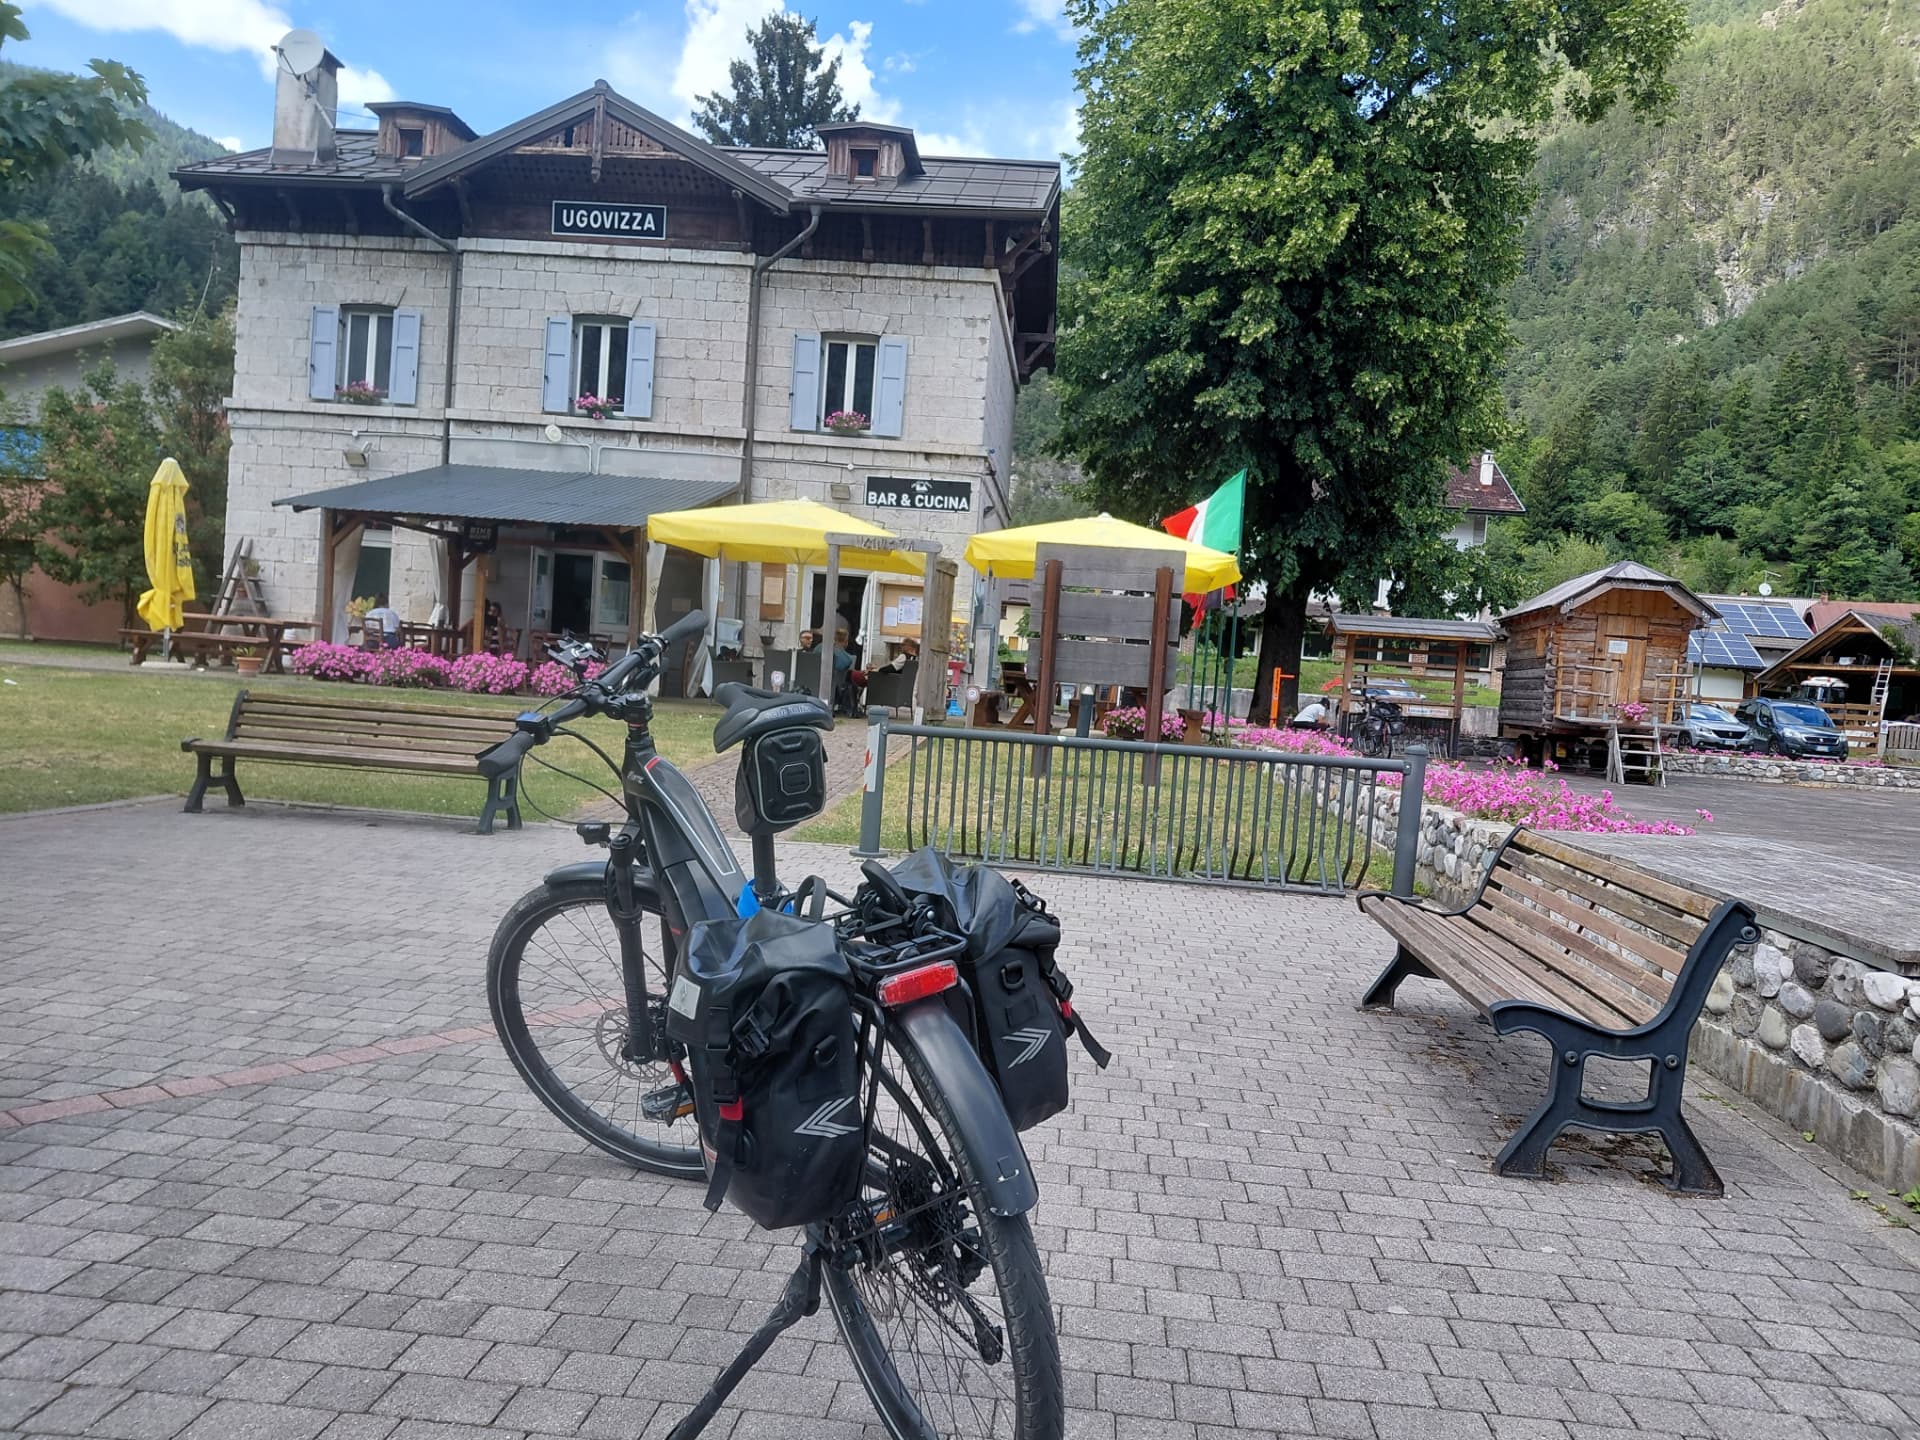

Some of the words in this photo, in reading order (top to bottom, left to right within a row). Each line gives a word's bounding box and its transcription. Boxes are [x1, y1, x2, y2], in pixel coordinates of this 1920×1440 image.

[562, 209, 656, 231] UGOVIZZA
[867, 491, 897, 506] BAR
[900, 493, 911, 507] &
[914, 494, 969, 510] CUCINA
